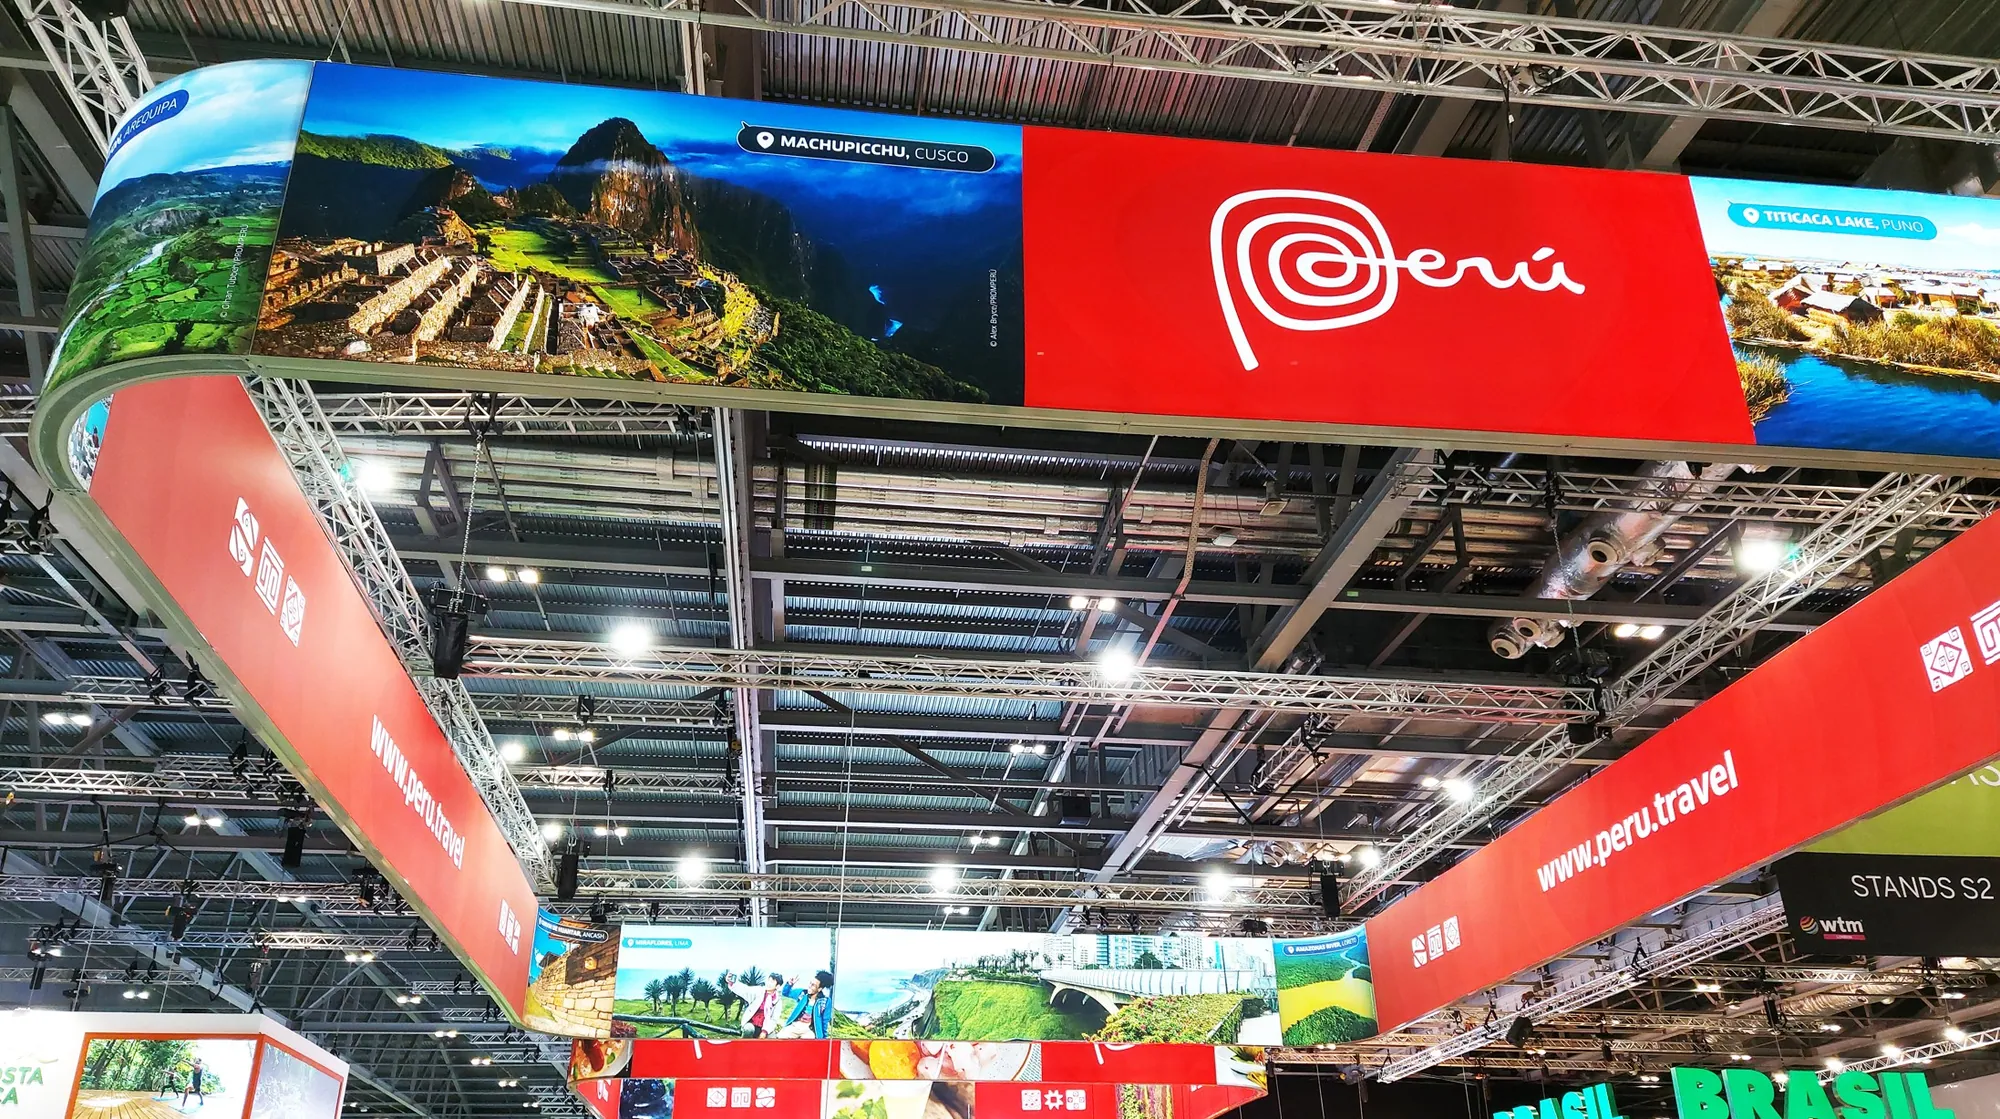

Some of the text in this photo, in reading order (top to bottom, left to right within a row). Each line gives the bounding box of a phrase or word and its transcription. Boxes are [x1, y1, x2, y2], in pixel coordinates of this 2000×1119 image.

[113, 98, 177, 138] AREQUIPA
[780, 135, 969, 163] MACHUPICCHU, CUSCO
[1763, 210, 1924, 233] TITICACA LAKE, PUNO
[370, 714, 466, 871] www.peru.travel
[1536, 749, 1739, 892] www.peru.travel
[1851, 875, 1995, 900] STANDS S2
[1819, 916, 1865, 933] wtm
[1671, 1066, 1954, 1119] BRASIL
